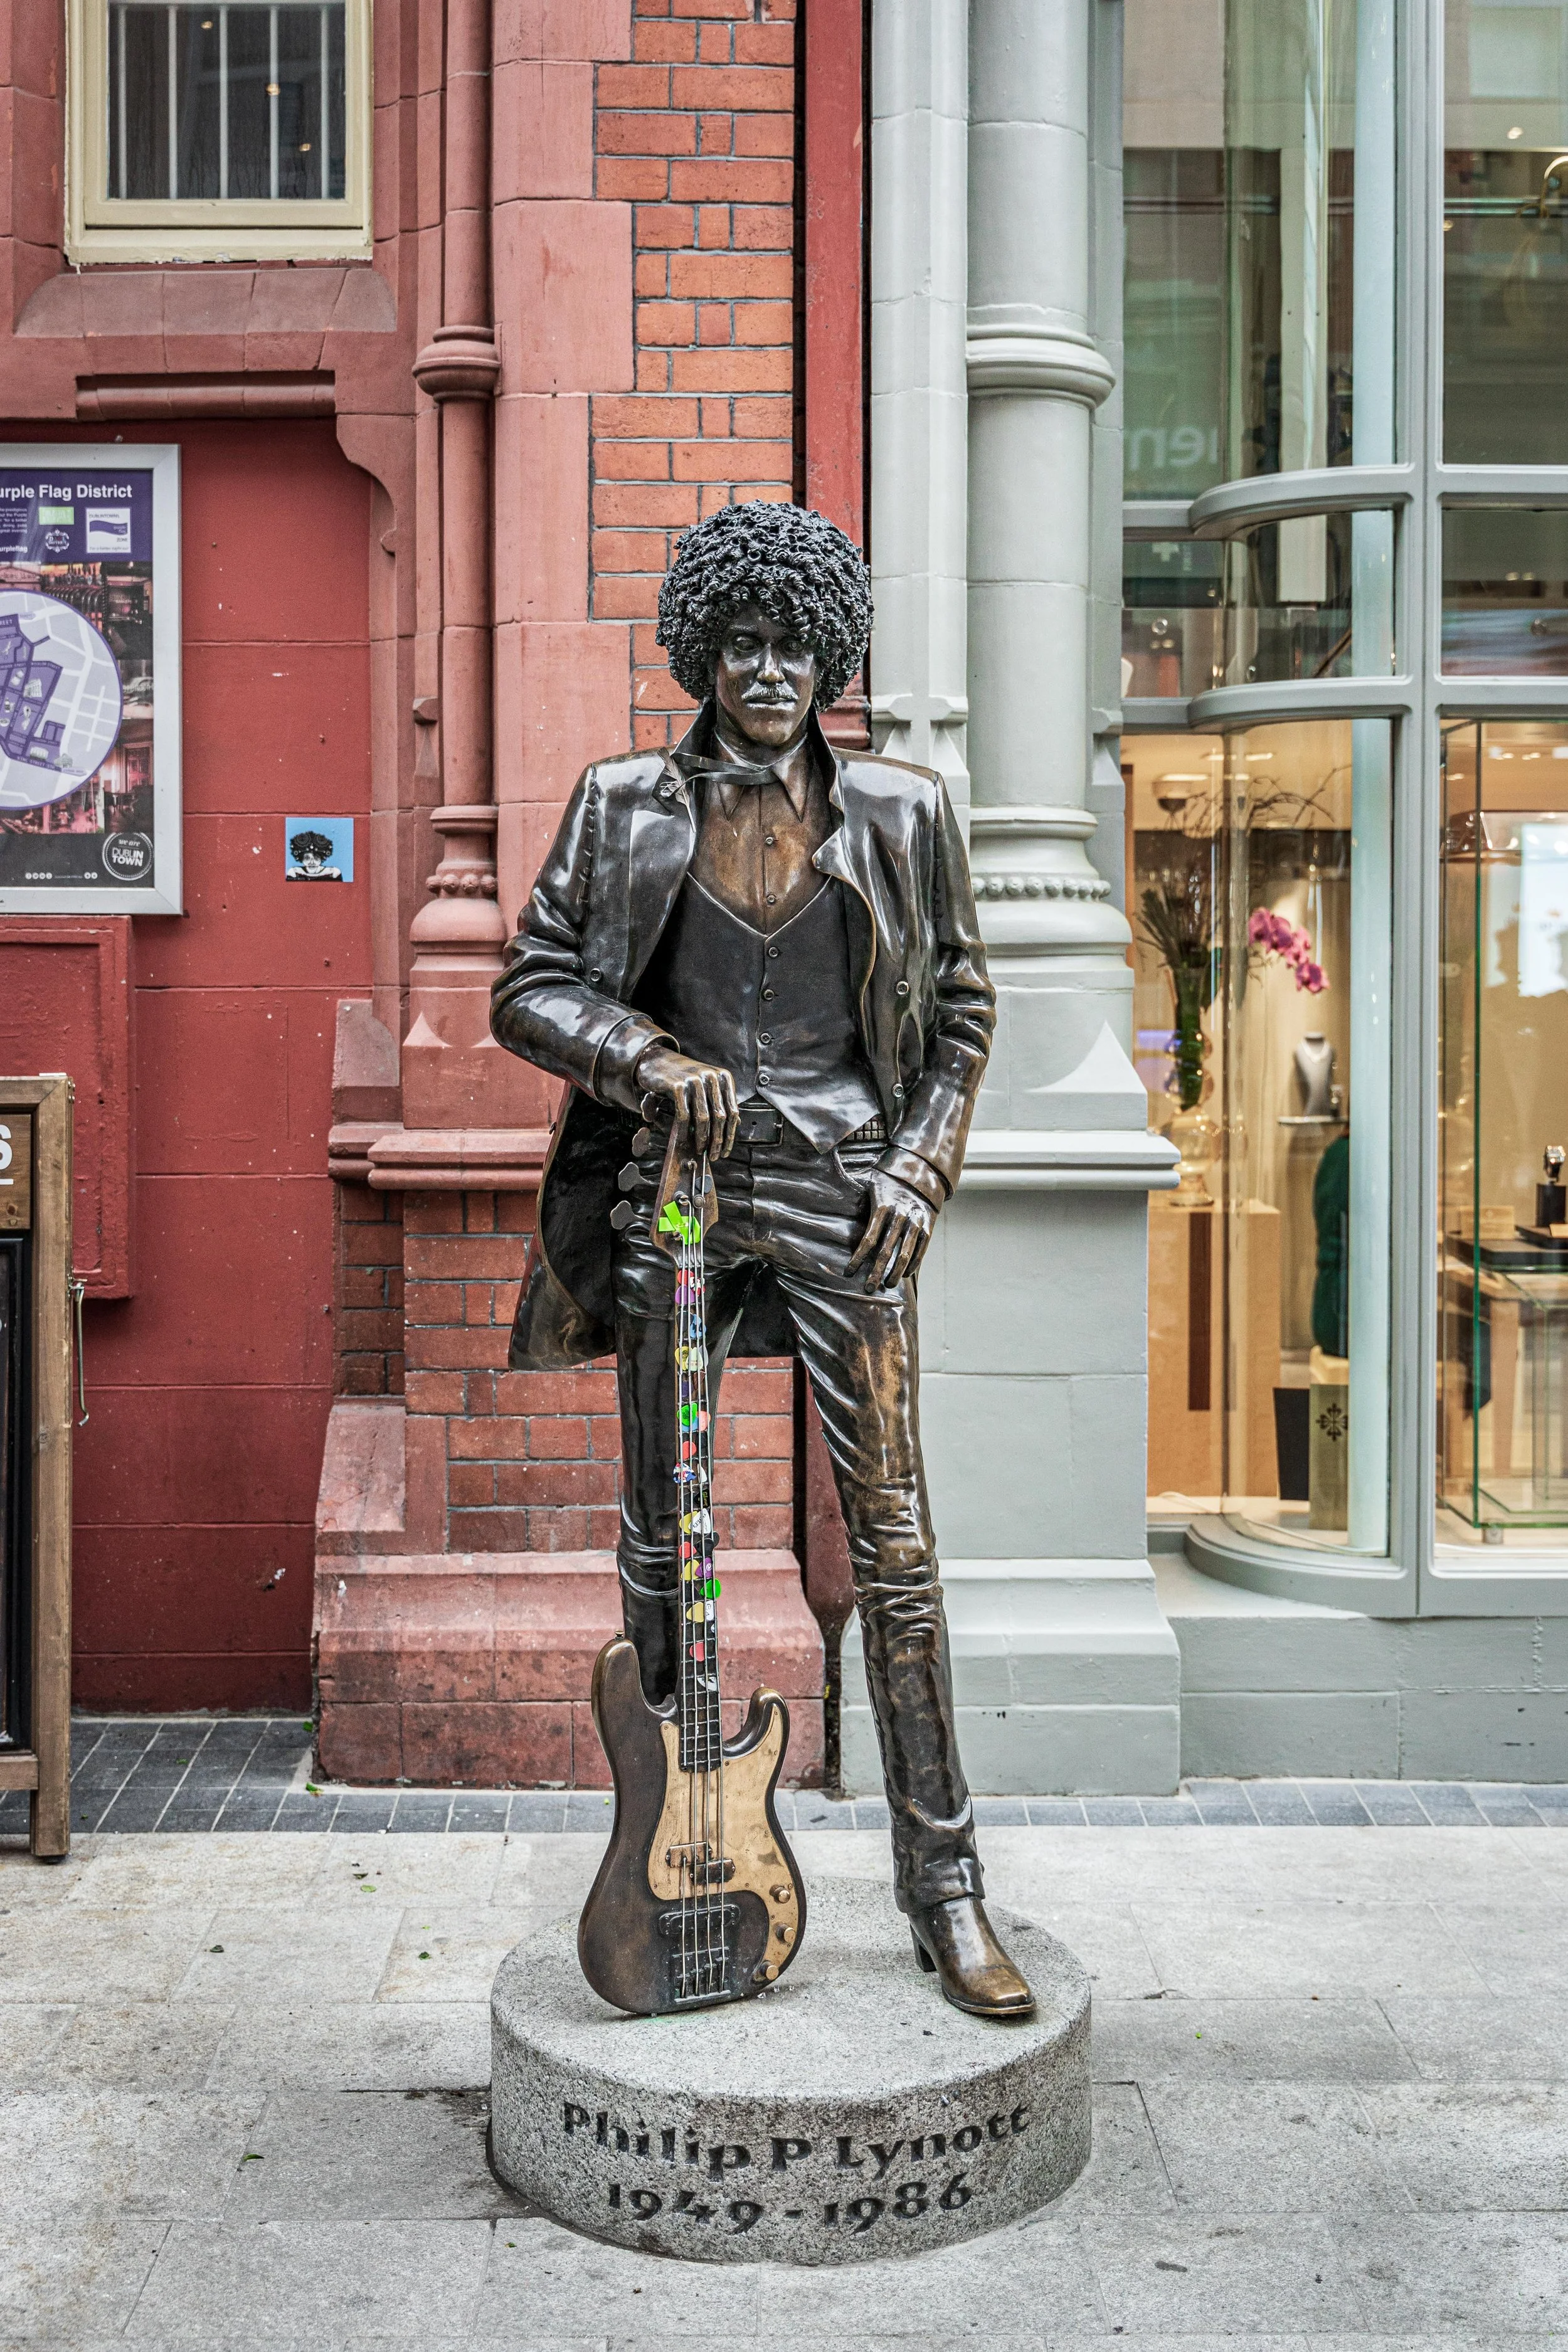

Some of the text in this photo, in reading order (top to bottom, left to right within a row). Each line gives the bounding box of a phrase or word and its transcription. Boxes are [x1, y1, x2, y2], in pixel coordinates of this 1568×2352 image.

[39, 484, 72, 501] Flag
[77, 484, 132, 498] District
[112, 847, 144, 859] DUBLIN
[112, 856, 142, 867] TOWN
[562, 2101, 1030, 2182] Philip P Lynott
[608, 2183, 764, 2236] 1949
[823, 2172, 973, 2236] 1986
